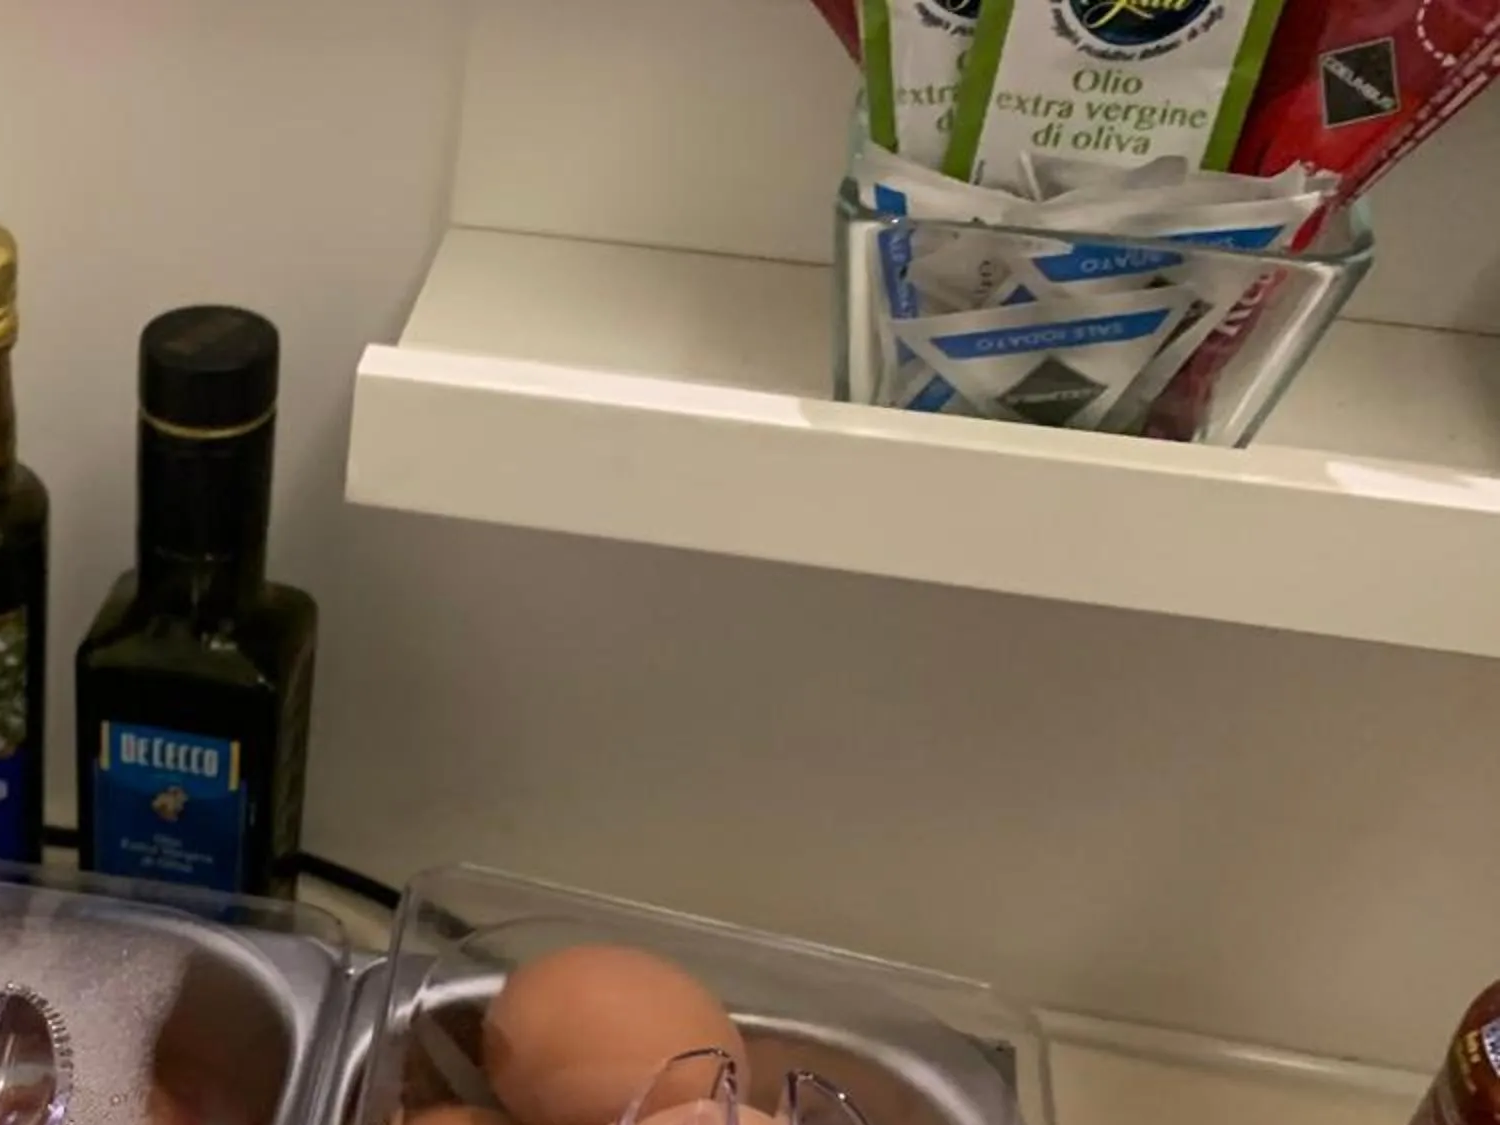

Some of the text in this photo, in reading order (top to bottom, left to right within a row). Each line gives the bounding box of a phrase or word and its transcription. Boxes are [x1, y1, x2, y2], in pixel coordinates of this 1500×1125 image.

[1071, 67, 1143, 96] Olio
[996, 91, 1209, 131] extra vergine
[1031, 121, 1151, 155] di oliva
